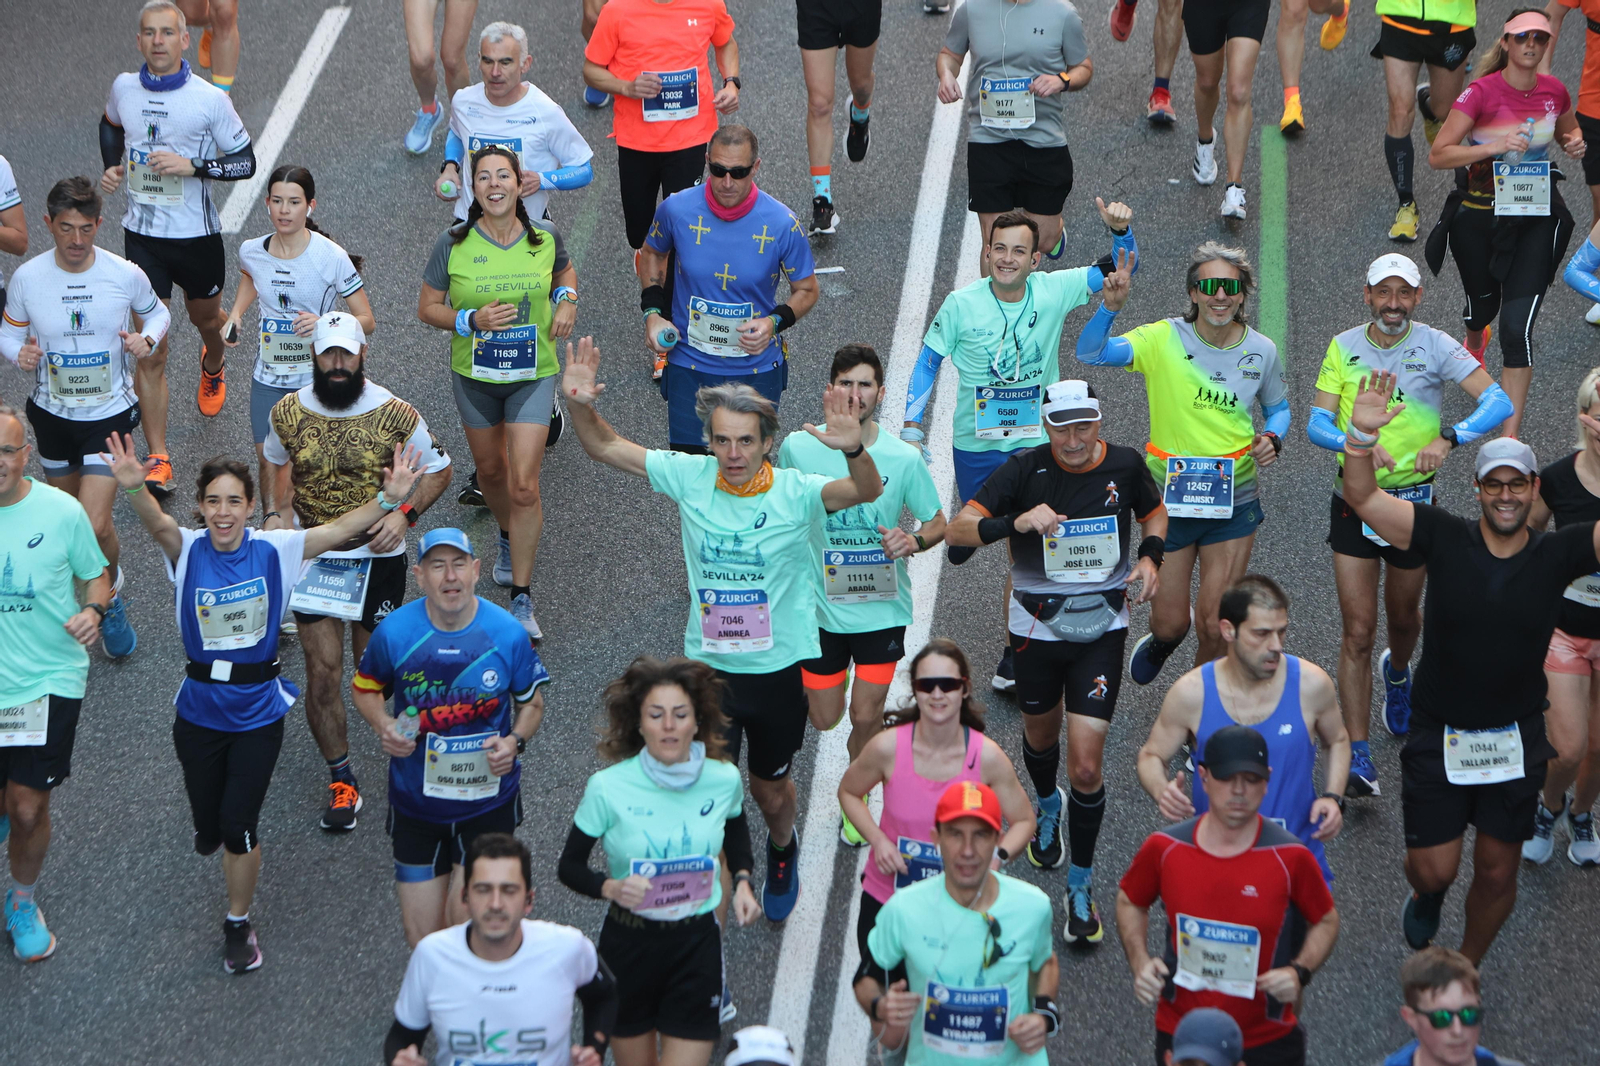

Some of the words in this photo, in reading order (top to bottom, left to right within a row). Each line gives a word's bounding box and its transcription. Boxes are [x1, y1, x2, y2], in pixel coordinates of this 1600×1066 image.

[662, 73, 692, 82] ZURICH
[995, 82, 1025, 90] ZURICH
[661, 91, 683, 100] 13032
[1514, 166, 1542, 174] ZURICH
[143, 173, 162, 182] 9180
[142, 185, 164, 193] JAVIER
[1512, 183, 1534, 192] 10877
[474, 254, 488, 264] edp
[476, 284, 492, 293] DE
[495, 281, 542, 292] SEVILLA
[712, 306, 745, 316] ZURICH
[710, 323, 730, 333] 8965
[496, 330, 529, 338] ZURICH
[709, 335, 728, 344] CHUS
[494, 349, 518, 358] 11639
[67, 356, 102, 366] ZURICH
[68, 376, 90, 384] 9223
[59, 386, 74, 394] LUIS
[76, 386, 102, 394] MIGUEL
[998, 390, 1033, 398] ZURICH
[1186, 482, 1212, 490] 12457
[1183, 495, 1215, 504] GIANSKY
[1070, 522, 1108, 533] ZURICH
[1068, 546, 1096, 554] 10916
[848, 554, 886, 562] ZURICH
[1064, 558, 1083, 568] JOSÉ
[318, 574, 346, 587] 11559
[702, 570, 764, 582] SEVILLA'24
[848, 574, 874, 582] 11114
[220, 586, 258, 601] ZURICH
[306, 586, 352, 600] BANDOLERO
[720, 592, 758, 602] ZURICH
[720, 616, 744, 625] 7046
[402, 670, 425, 682] LOS
[456, 775, 488, 784] BLANCO
[661, 861, 704, 874] ZURICH
[1204, 925, 1248, 942] ZURICH
[954, 992, 999, 1004] ZURICH
[950, 1014, 982, 1026] 11487
